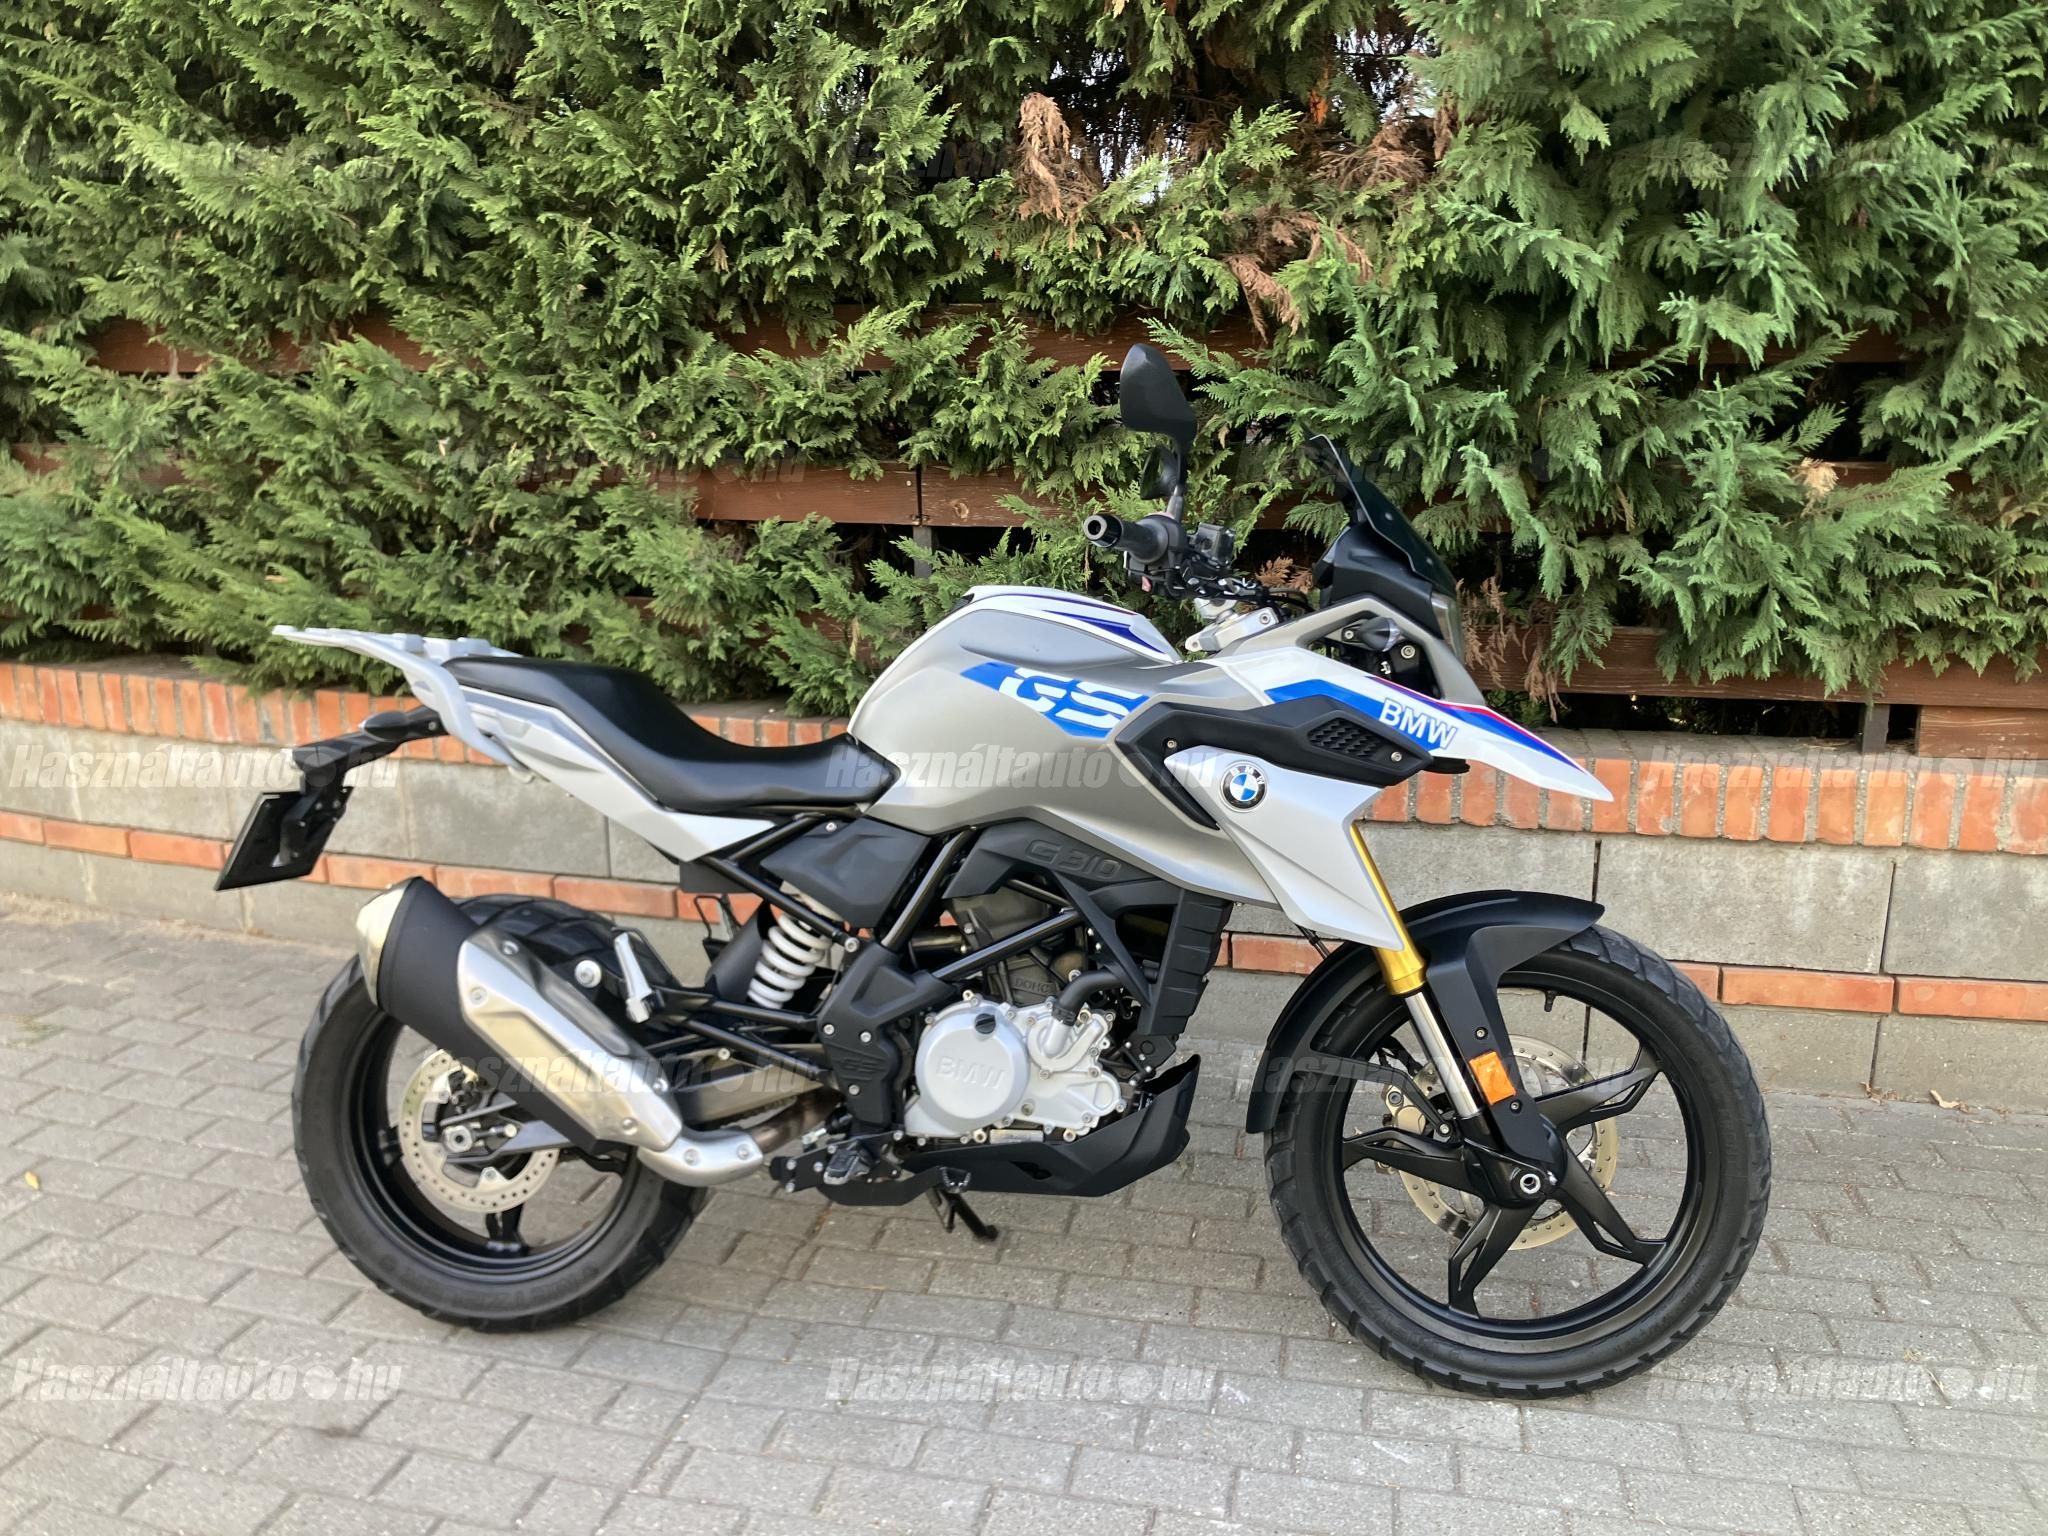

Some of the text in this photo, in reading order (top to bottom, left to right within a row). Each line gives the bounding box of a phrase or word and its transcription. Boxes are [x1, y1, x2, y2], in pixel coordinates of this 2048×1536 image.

[999, 667, 1143, 729] GS
[1378, 697, 1458, 750] BMW
[935, 1055, 1009, 1089] BMW
